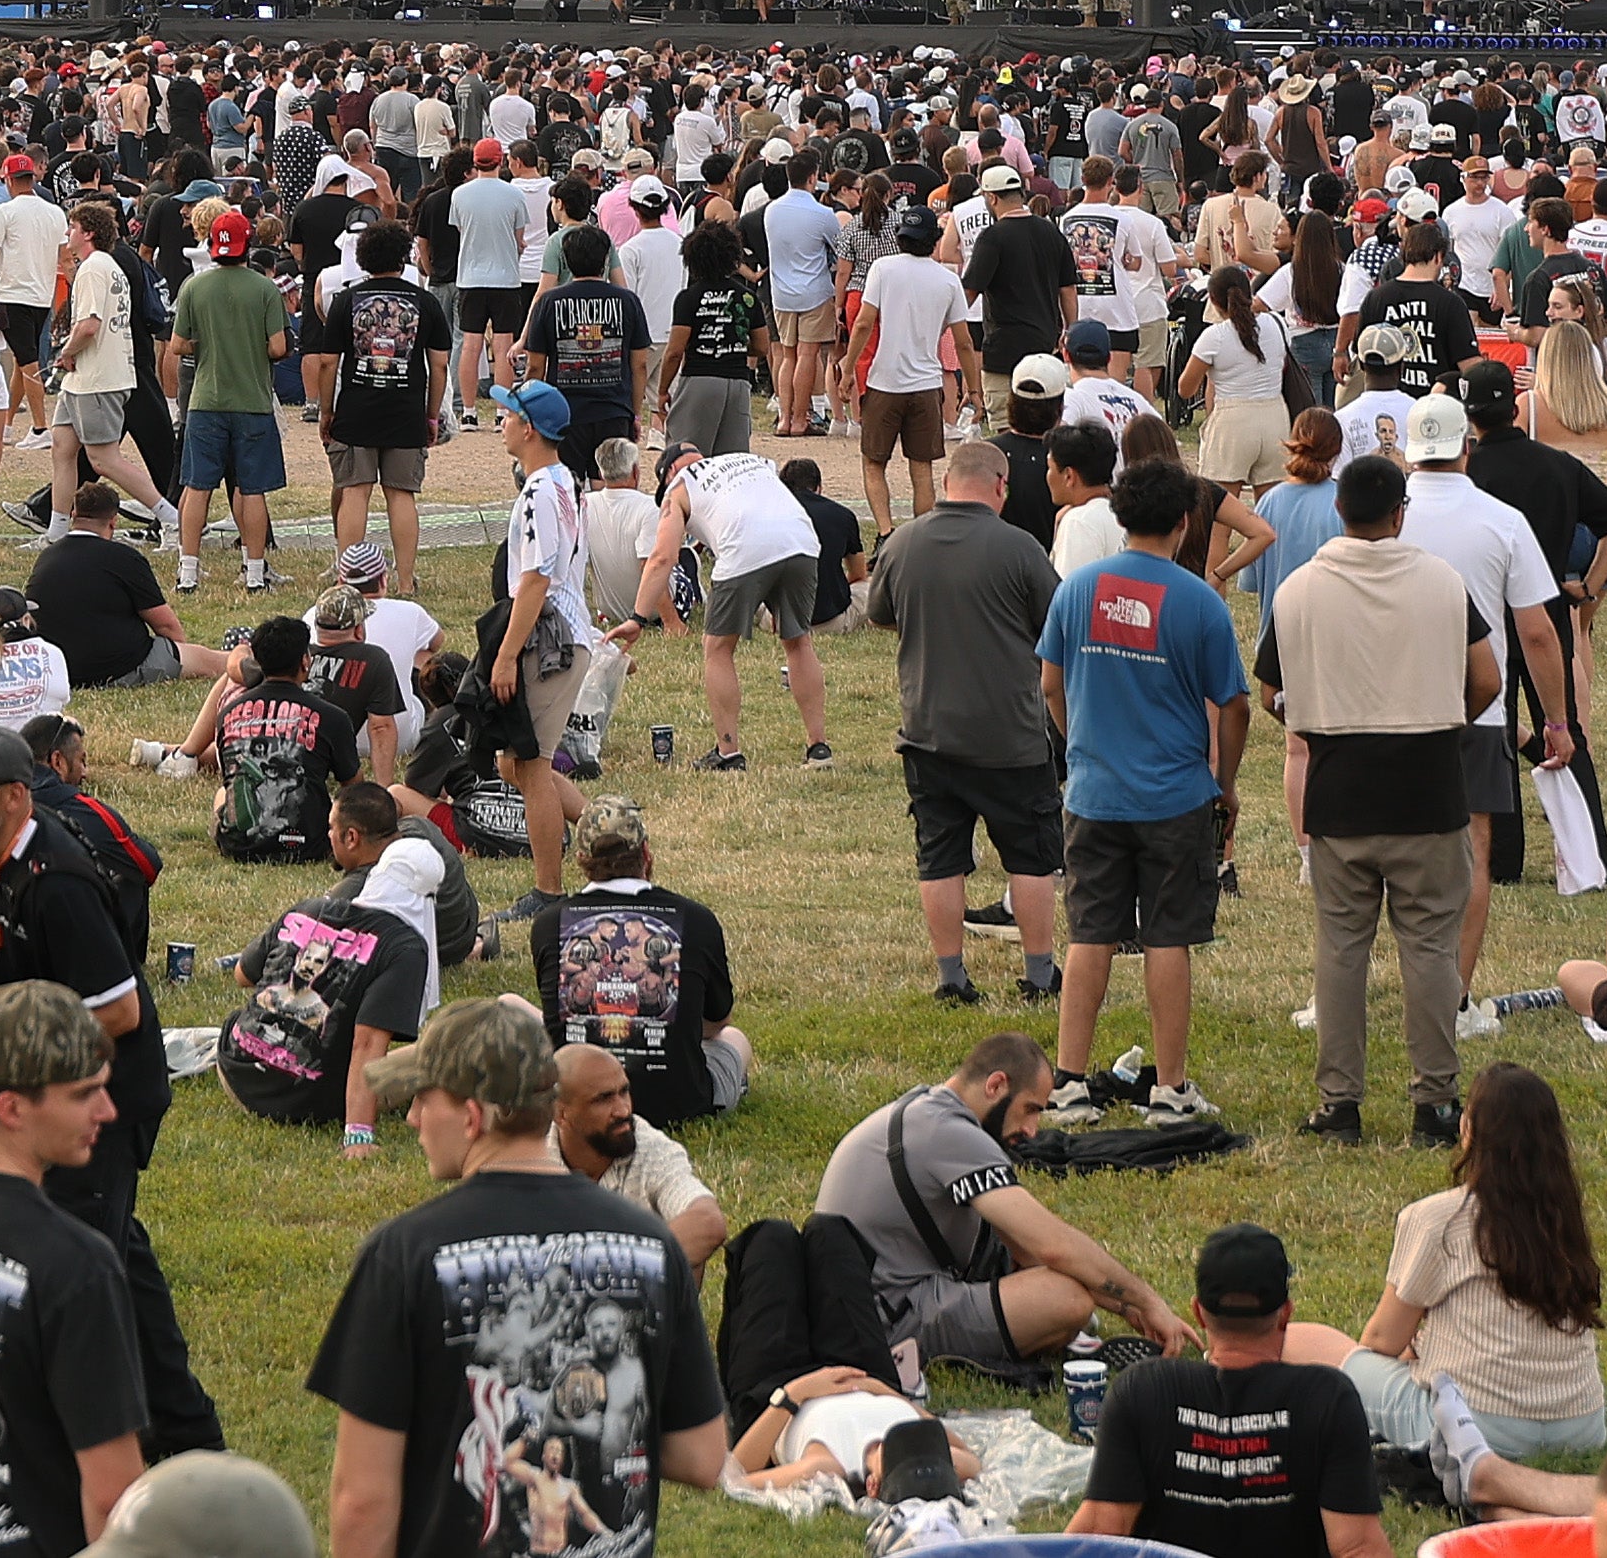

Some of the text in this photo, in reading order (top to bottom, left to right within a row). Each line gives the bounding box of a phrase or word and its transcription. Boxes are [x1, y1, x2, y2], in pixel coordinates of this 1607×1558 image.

[554, 297, 624, 339] FC BARCELONA
[1385, 301, 1427, 322] ANTI
[700, 472, 720, 492] ZAC
[1121, 650, 1167, 664] EXPLORING
[265, 699, 320, 751] LOPES
[597, 982, 637, 992] FREEDOM
[609, 991, 625, 999] 250
[1177, 1406, 1197, 1426] THE
[1175, 1451, 1198, 1469] THE
[1221, 1459, 1237, 1478] OF
